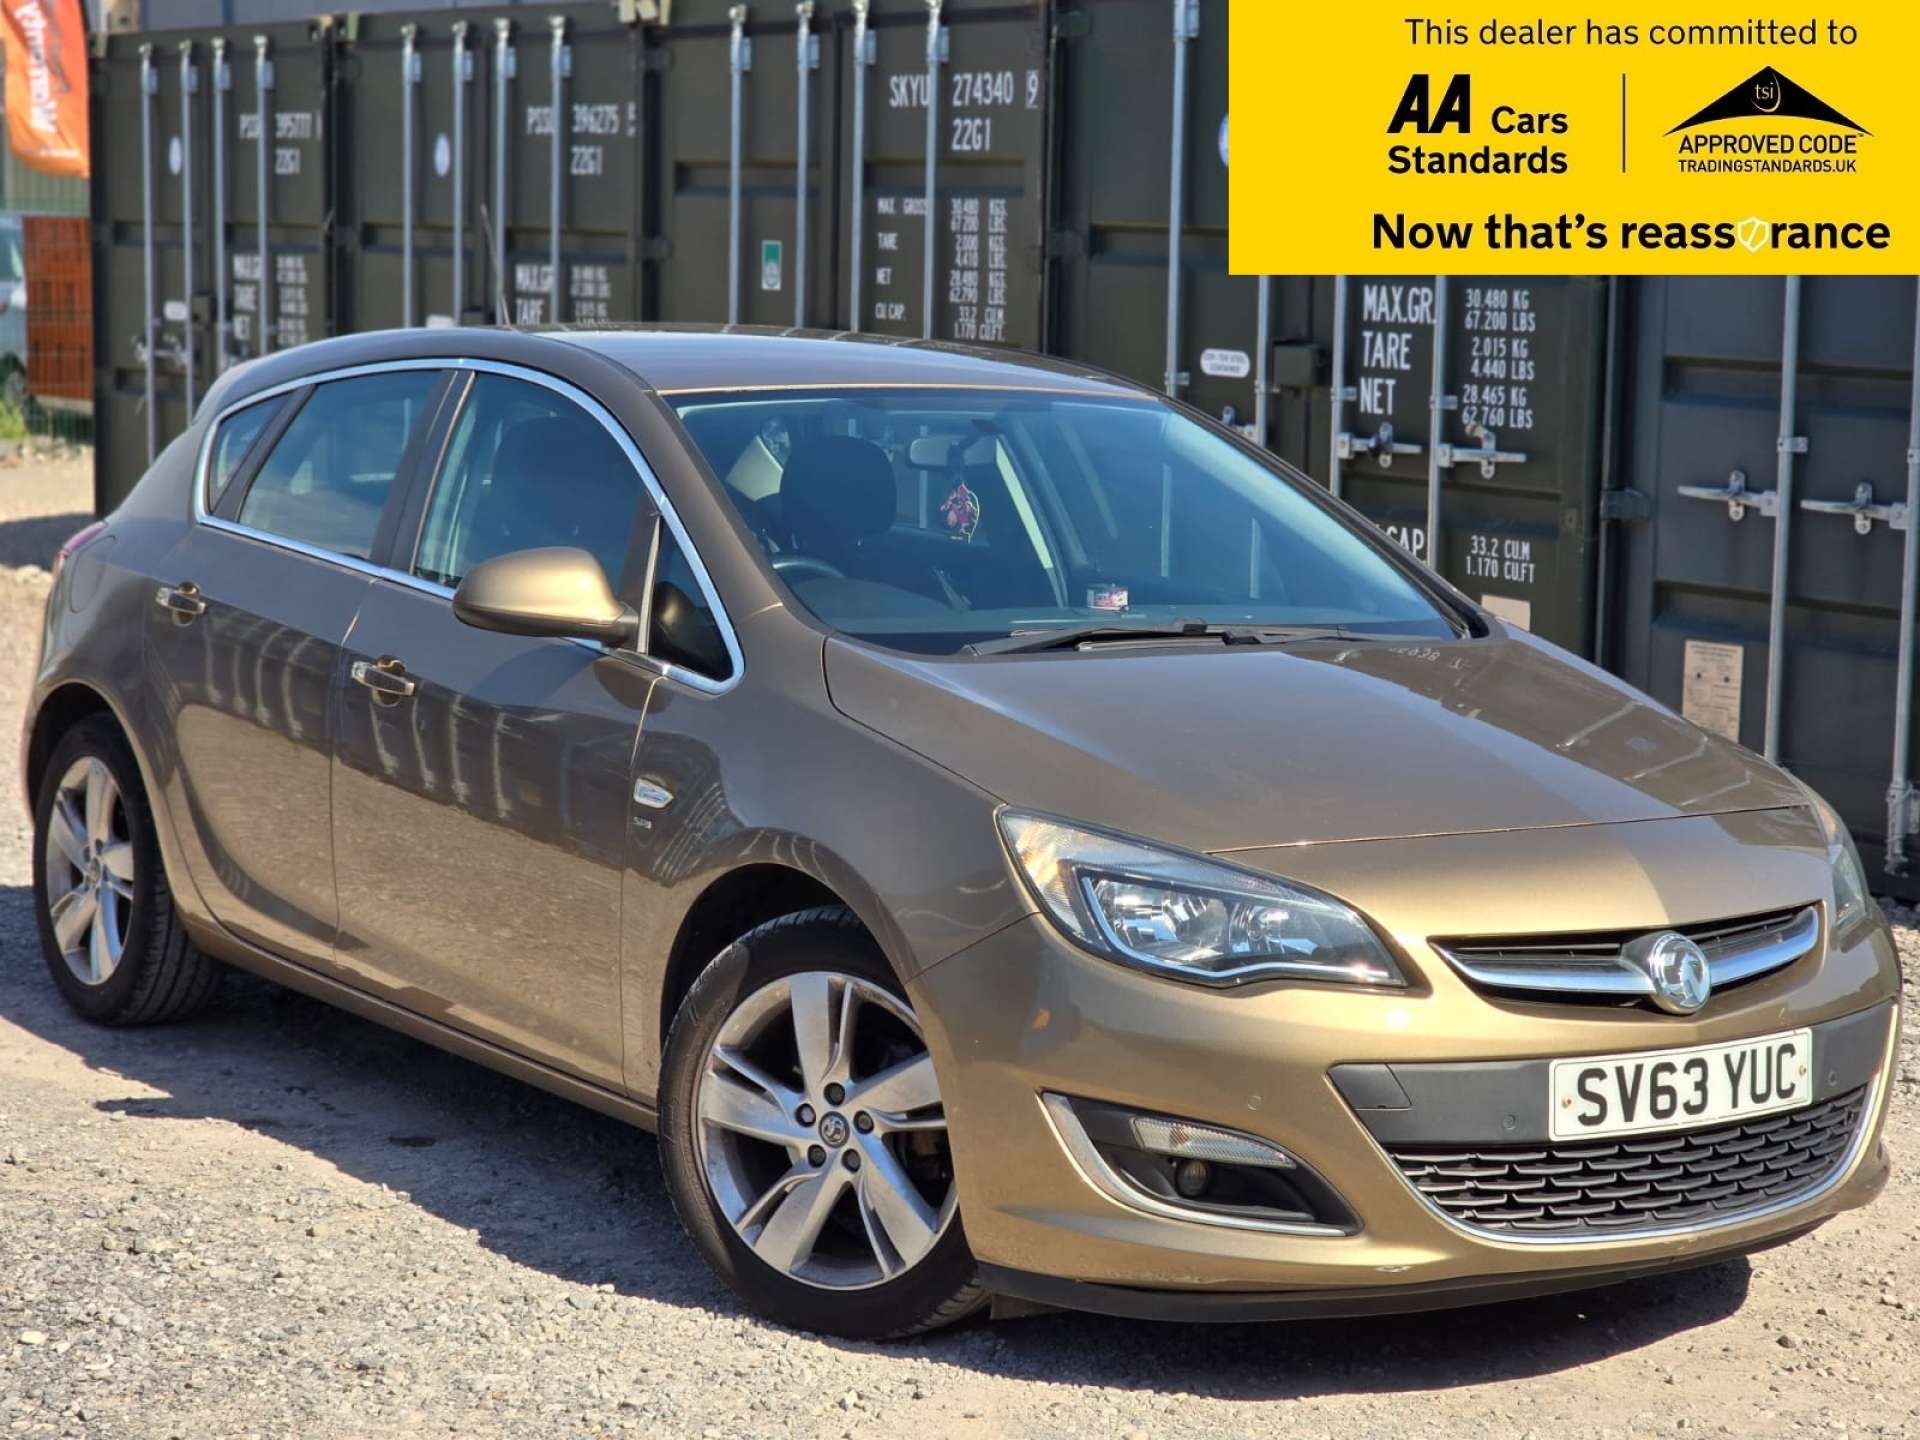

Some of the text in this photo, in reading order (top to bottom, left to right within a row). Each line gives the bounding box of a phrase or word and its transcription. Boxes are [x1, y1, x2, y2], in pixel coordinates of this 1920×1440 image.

[952, 71, 1014, 107] 274340
[952, 117, 991, 151] 22G1
[1465, 288, 1508, 309] 30.480
[1512, 290, 1530, 310] KG
[1464, 310, 1536, 332] 67.200 LBS
[1362, 331, 1529, 371] TARE 2.015 KG
[1470, 359, 1535, 380] 4.440 LBS
[1360, 376, 1527, 415] NET 28.465 KG
[1461, 406, 1534, 428] 62760 LBS
[1471, 535, 1499, 557] 33.2
[1466, 556, 1499, 577] 1.170
[1577, 1043, 1796, 1127] SV63 YUC
